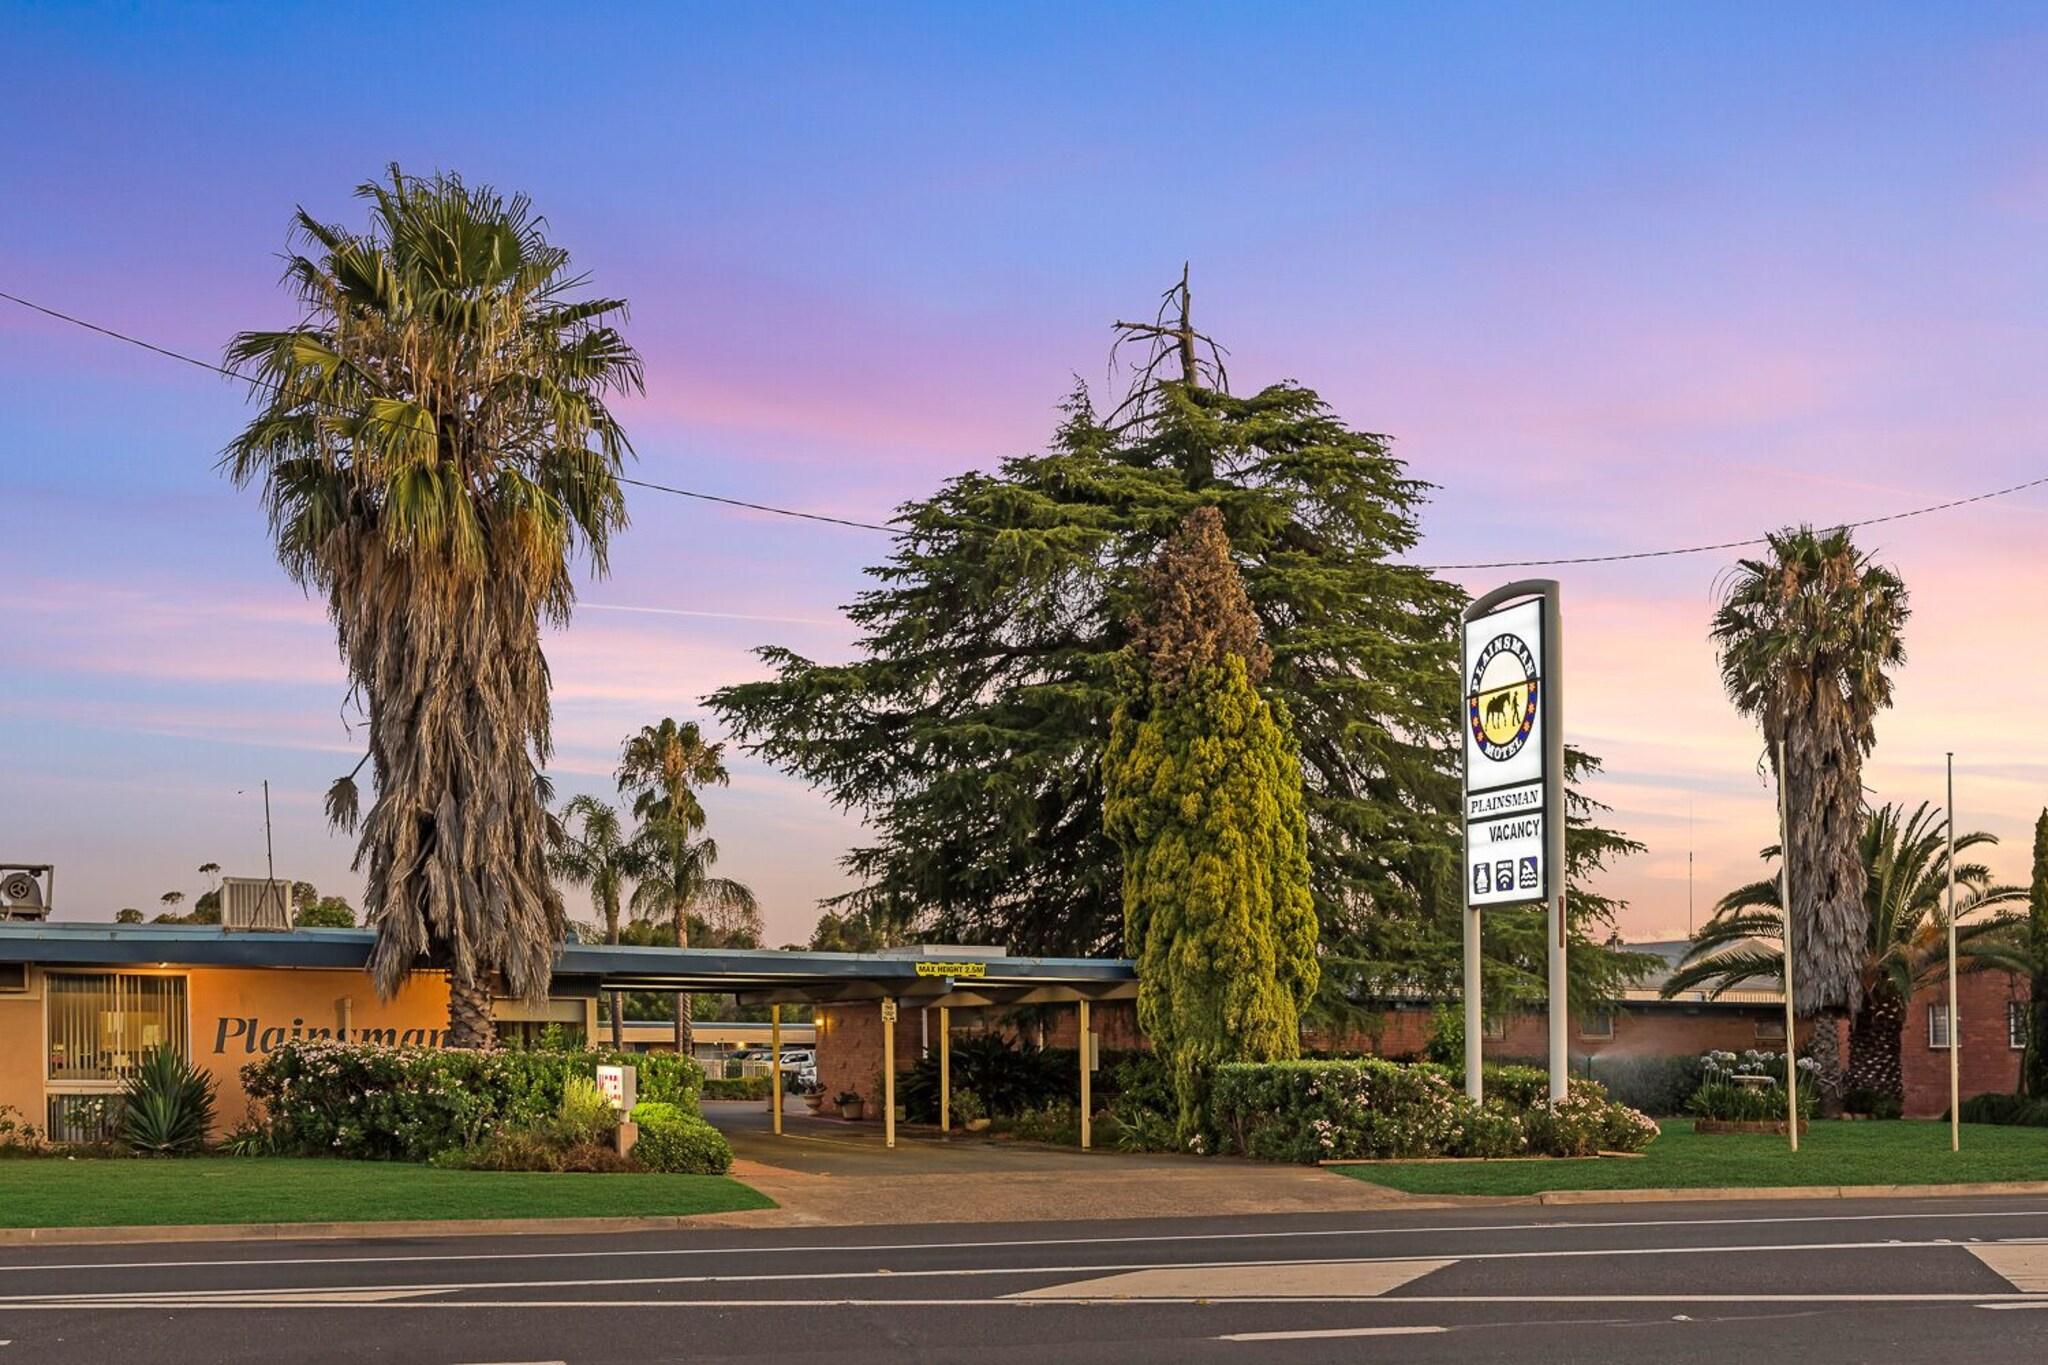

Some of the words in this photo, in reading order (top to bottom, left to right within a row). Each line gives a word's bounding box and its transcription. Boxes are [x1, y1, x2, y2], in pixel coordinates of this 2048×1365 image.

[1472, 636, 1535, 692] PLAINSMAN
[1485, 737, 1523, 759] MOTEL
[1471, 790, 1538, 813] PLAINSMAN
[1489, 819, 1540, 842] VACANCY
[918, 965, 935, 973] MAX
[938, 965, 962, 973] HEIGHT
[964, 965, 984, 973] 2.5M
